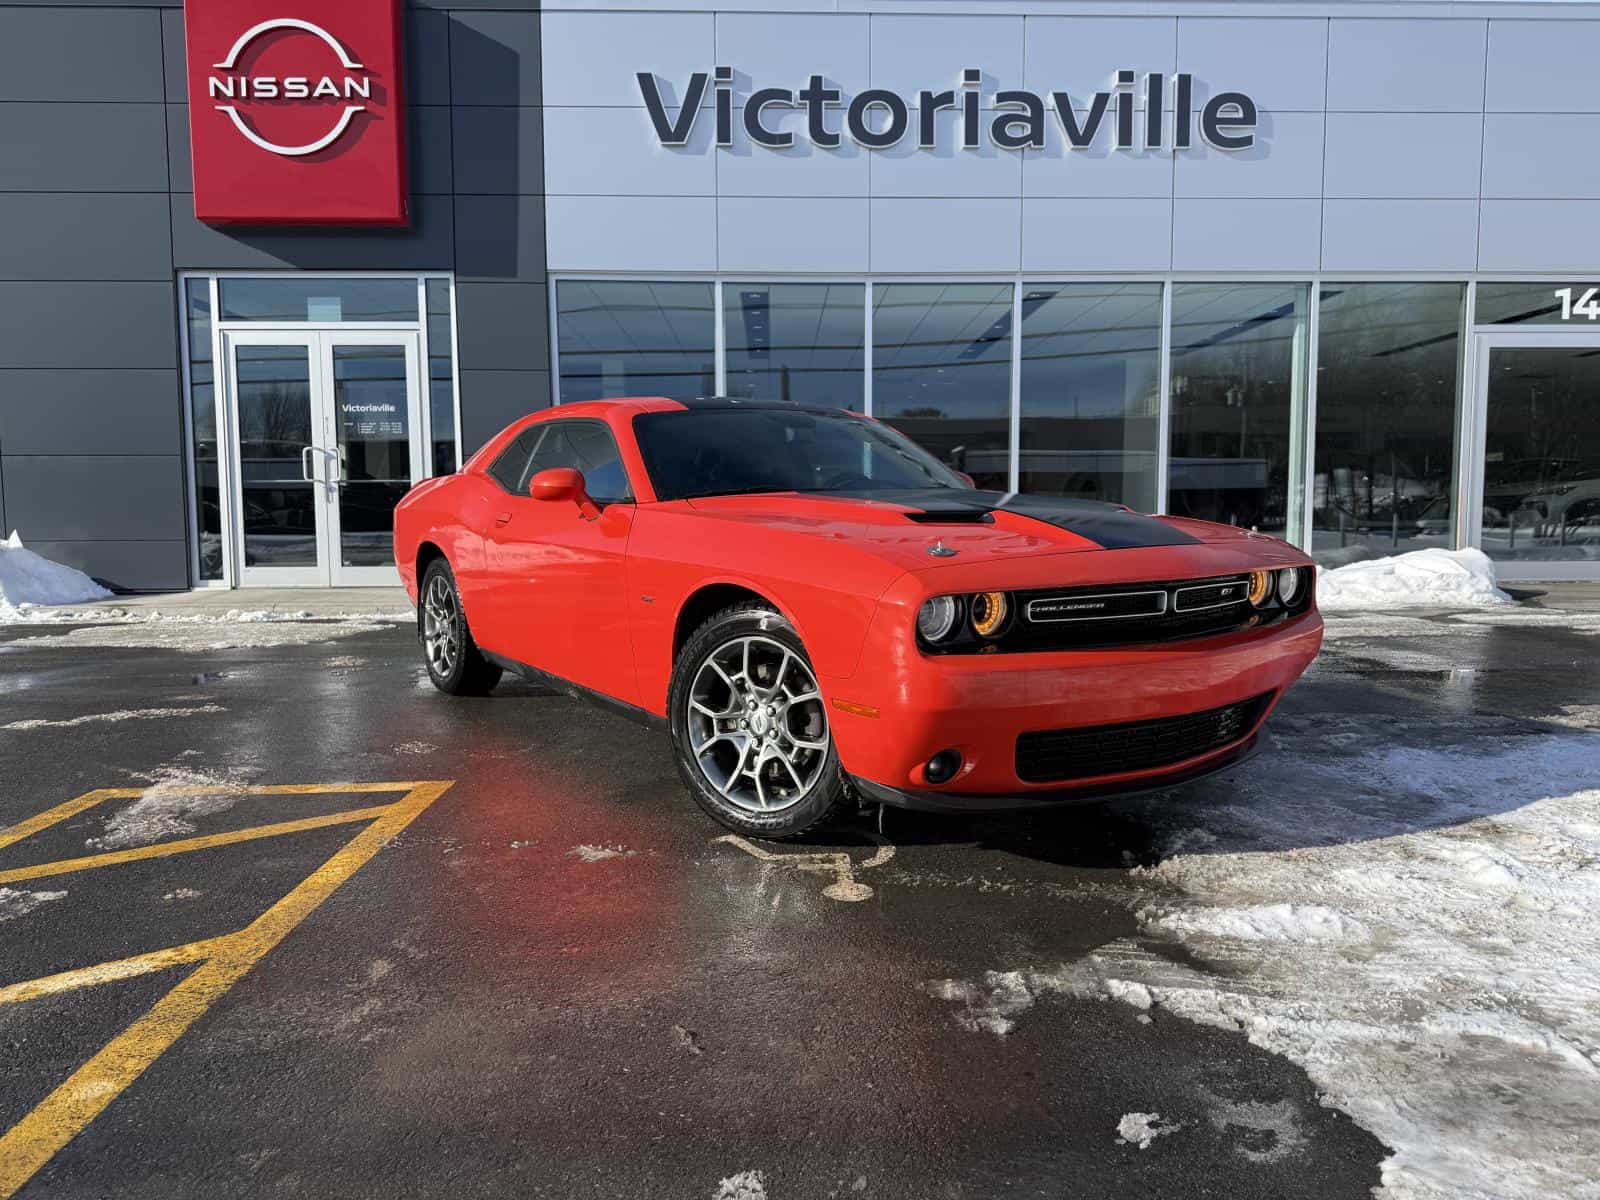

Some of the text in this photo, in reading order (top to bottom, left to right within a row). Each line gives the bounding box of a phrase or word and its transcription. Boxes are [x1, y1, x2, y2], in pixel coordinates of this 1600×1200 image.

[208, 76, 370, 98] NISSAN
[636, 66, 1257, 149] Victoriaville
[1554, 287, 1600, 320] 14
[342, 403, 396, 412] Victoriaville
